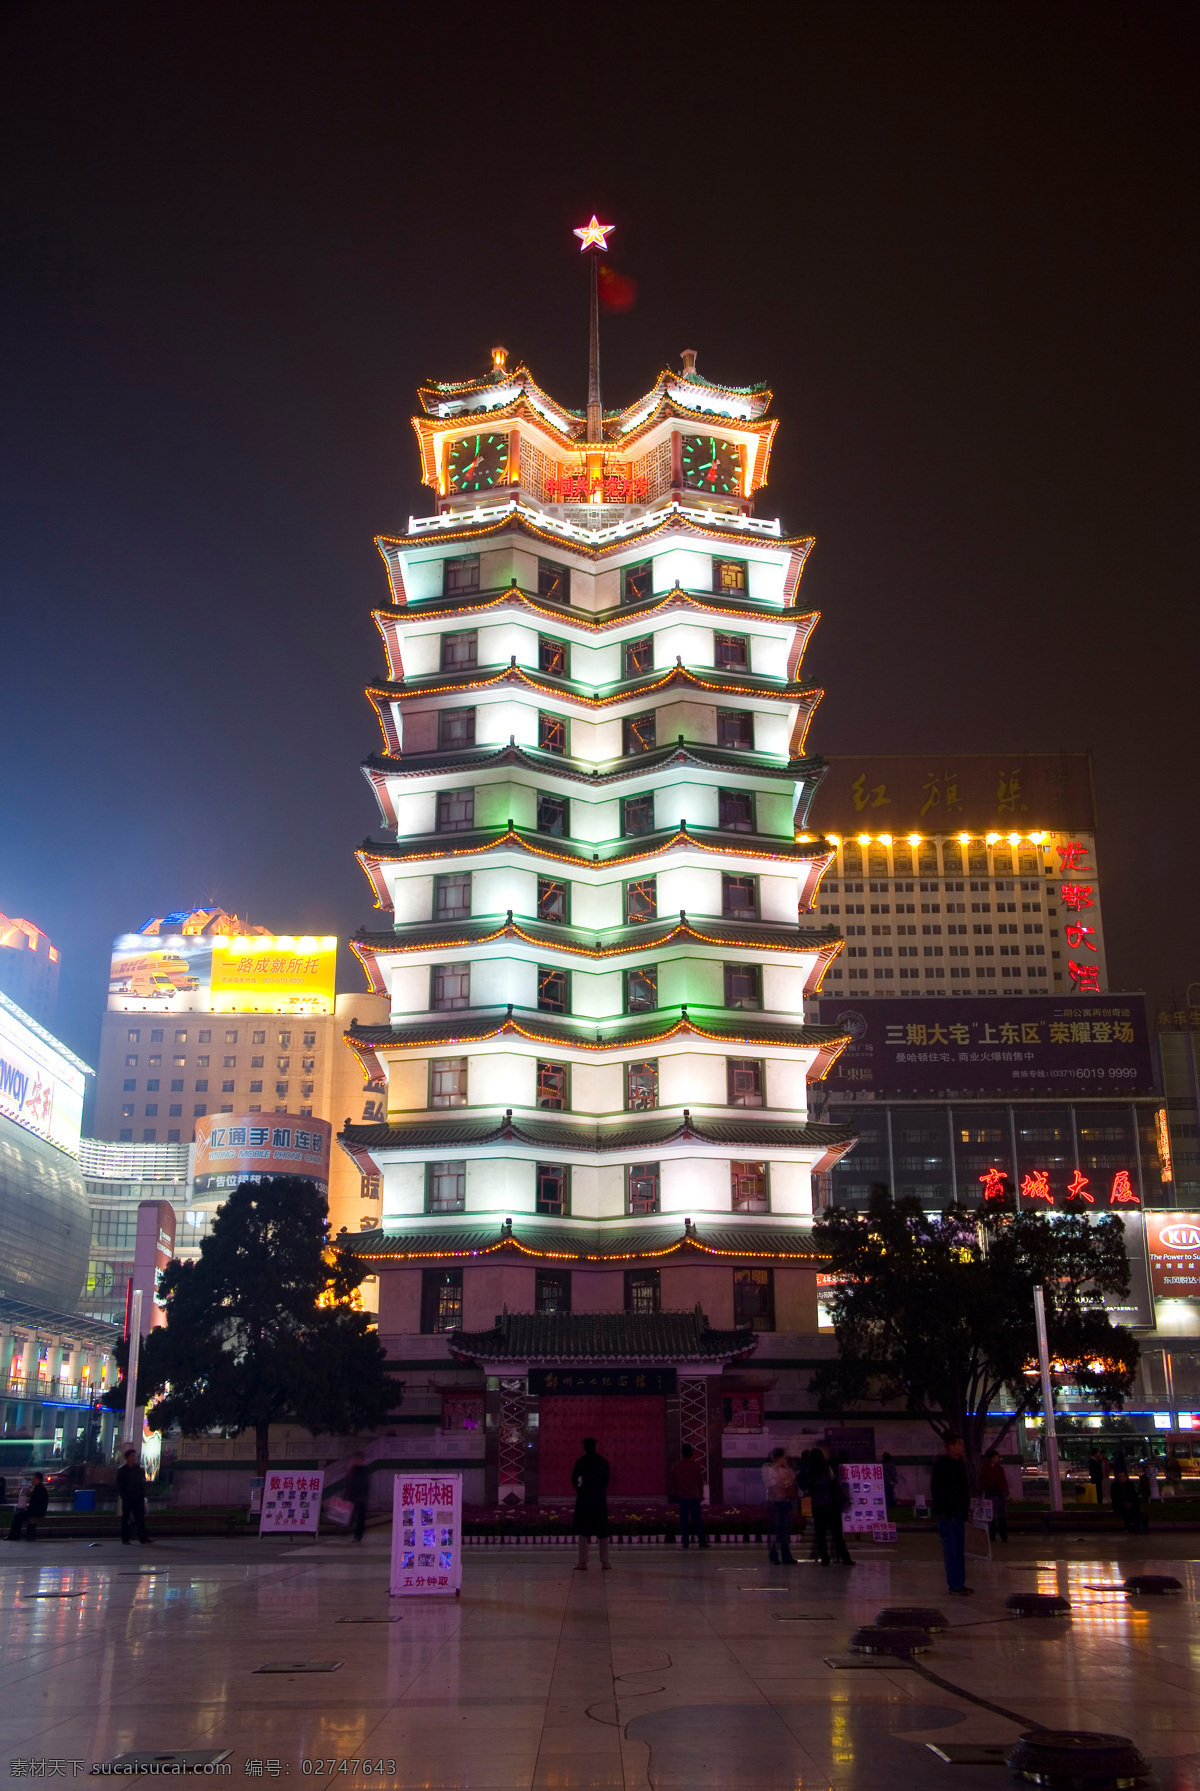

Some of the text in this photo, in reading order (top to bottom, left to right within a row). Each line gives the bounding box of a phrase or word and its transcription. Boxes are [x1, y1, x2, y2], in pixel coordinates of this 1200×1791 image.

[545, 476, 649, 497] 中国共产党万岁
[221, 957, 320, 974] 一路成就所托
[288, 997, 320, 1006] DHL
[1053, 1008, 1131, 1018] 二期公寓再创奇迹
[1108, 1067, 1137, 1079] 9999
[208, 1150, 236, 1161] YITONG
[238, 1148, 272, 1159] MOBILE
[273, 1150, 303, 1162] PHONE
[979, 1168, 1141, 1205] 商城大厦
[1167, 1230, 1200, 1244] KIA
[270, 1476, 320, 1491] 数码快相
[401, 1481, 454, 1507] 数码快相
[403, 1576, 449, 1587] 五分钟取
